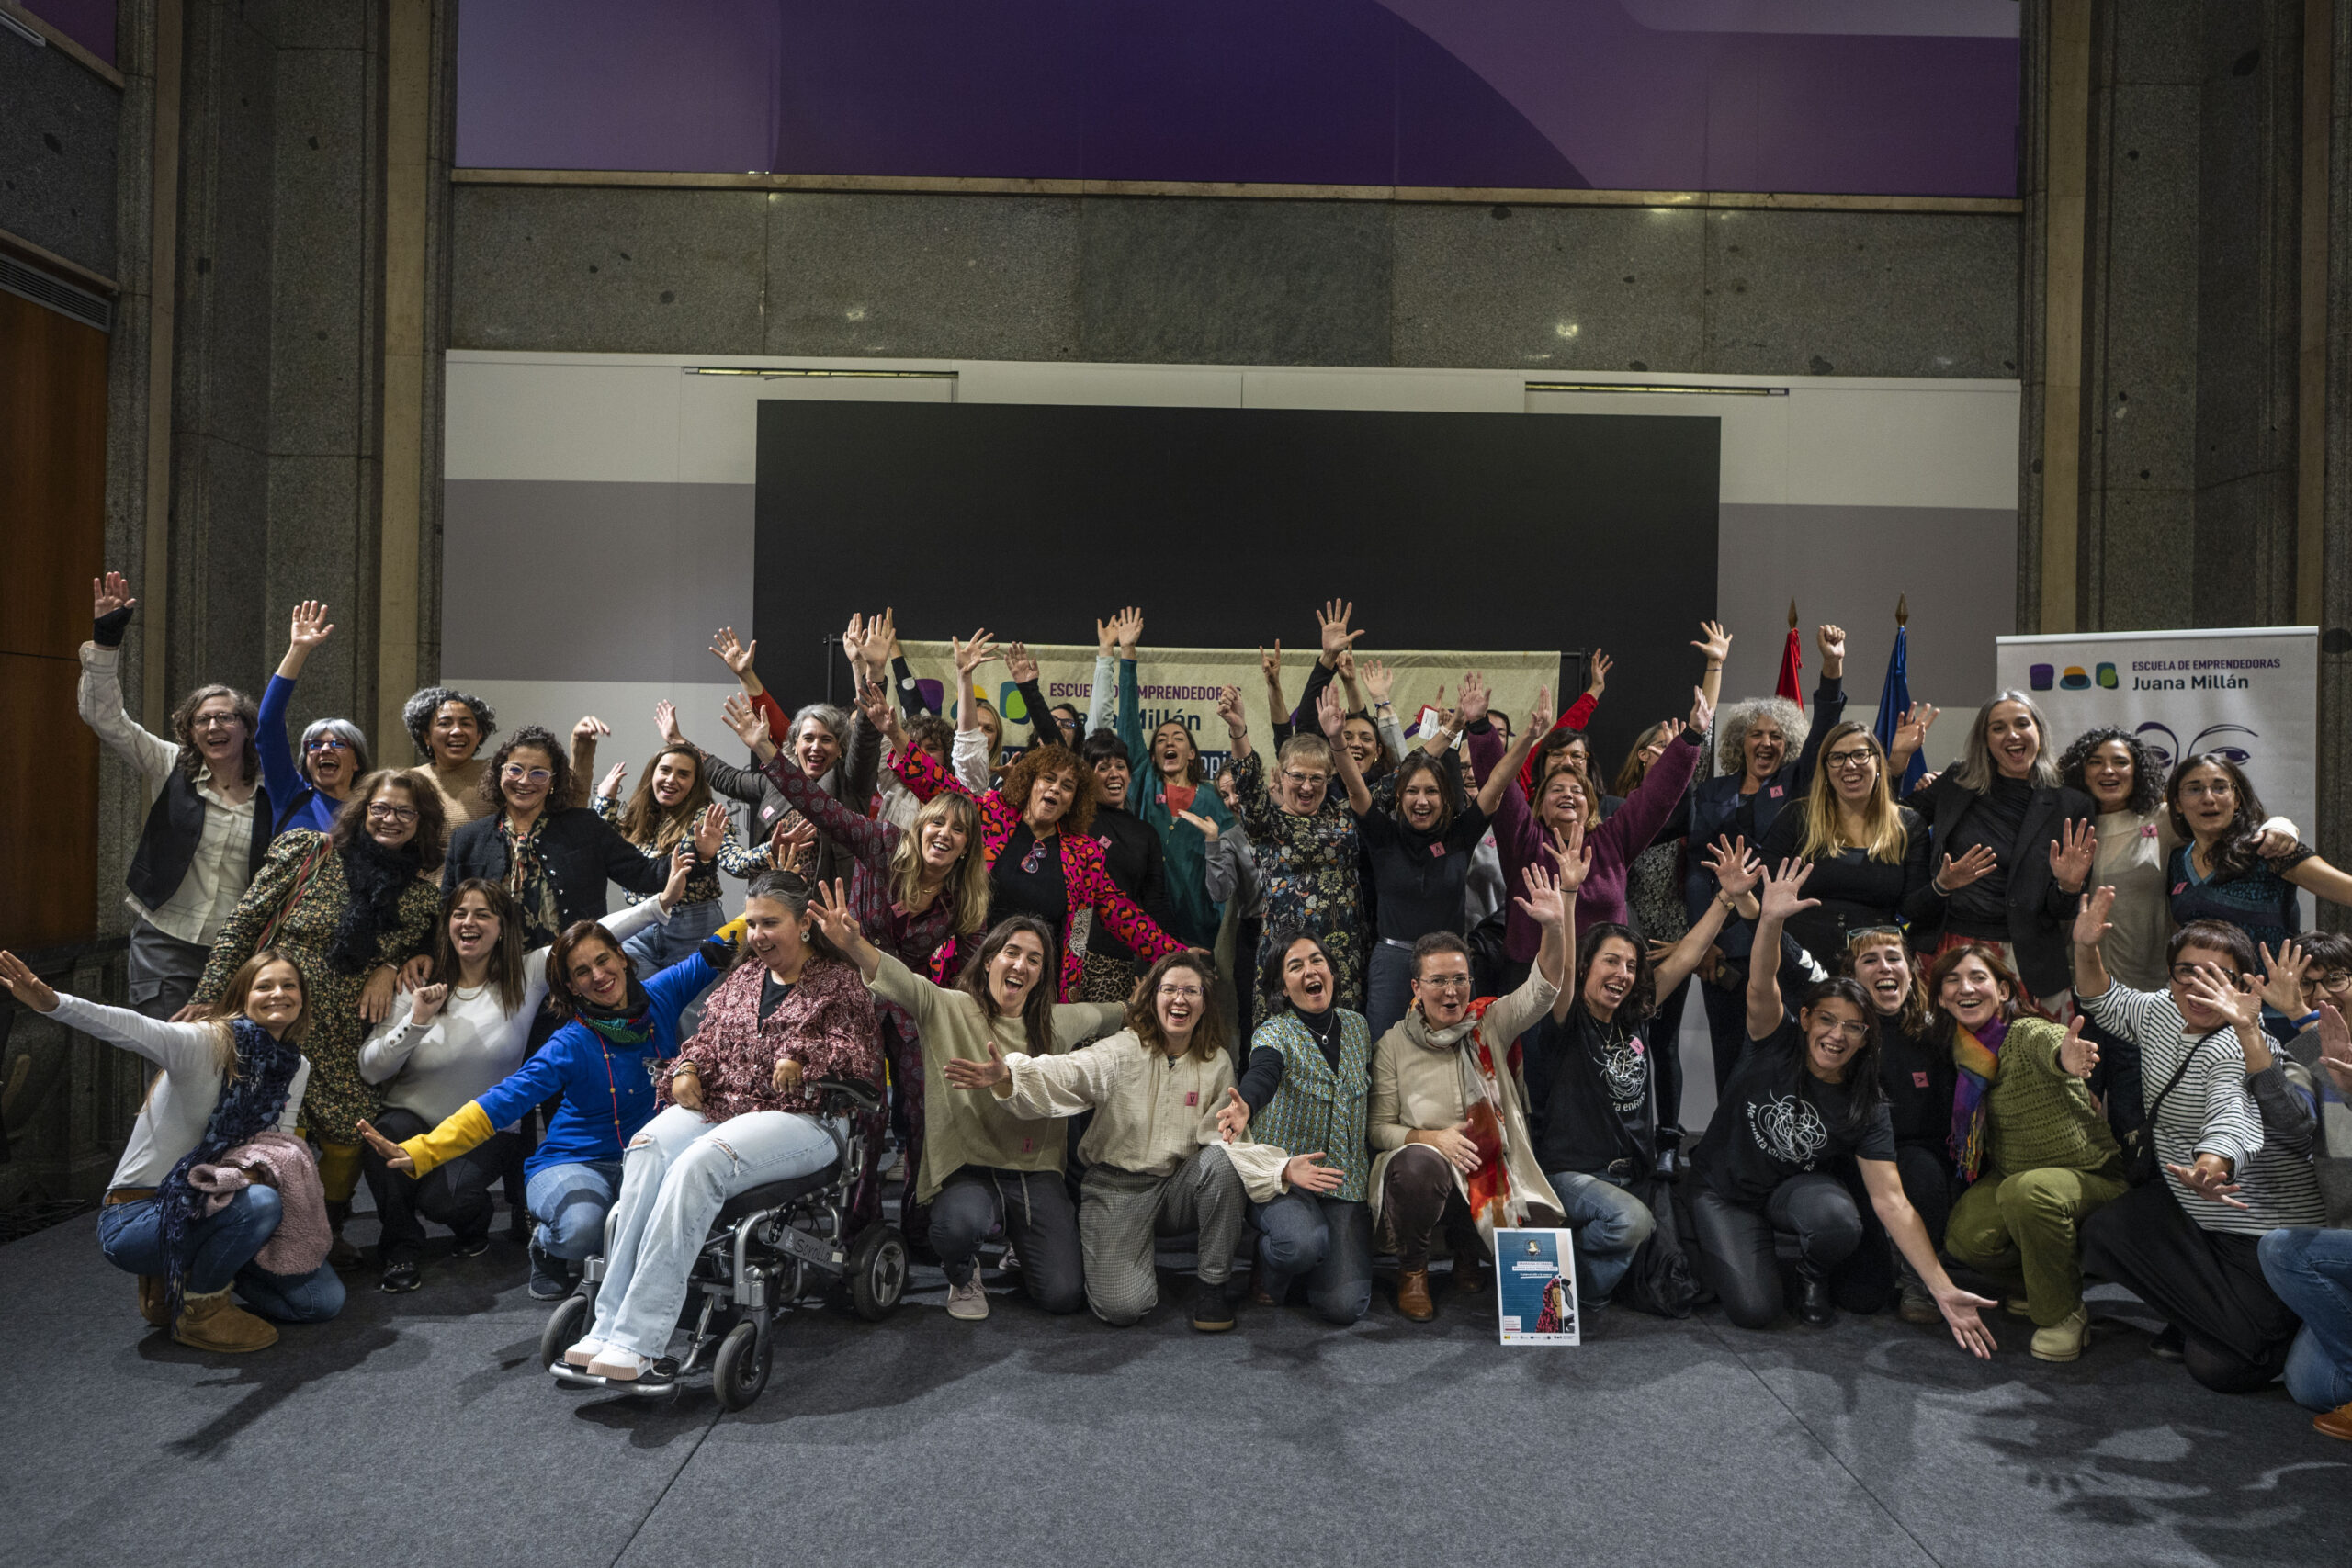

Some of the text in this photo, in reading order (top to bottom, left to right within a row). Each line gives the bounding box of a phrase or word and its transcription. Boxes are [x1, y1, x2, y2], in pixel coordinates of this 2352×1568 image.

[2132, 658, 2281, 671] ESCUELA DE EMPRENDEDORAS
[2132, 673, 2249, 691] Juana Millán
